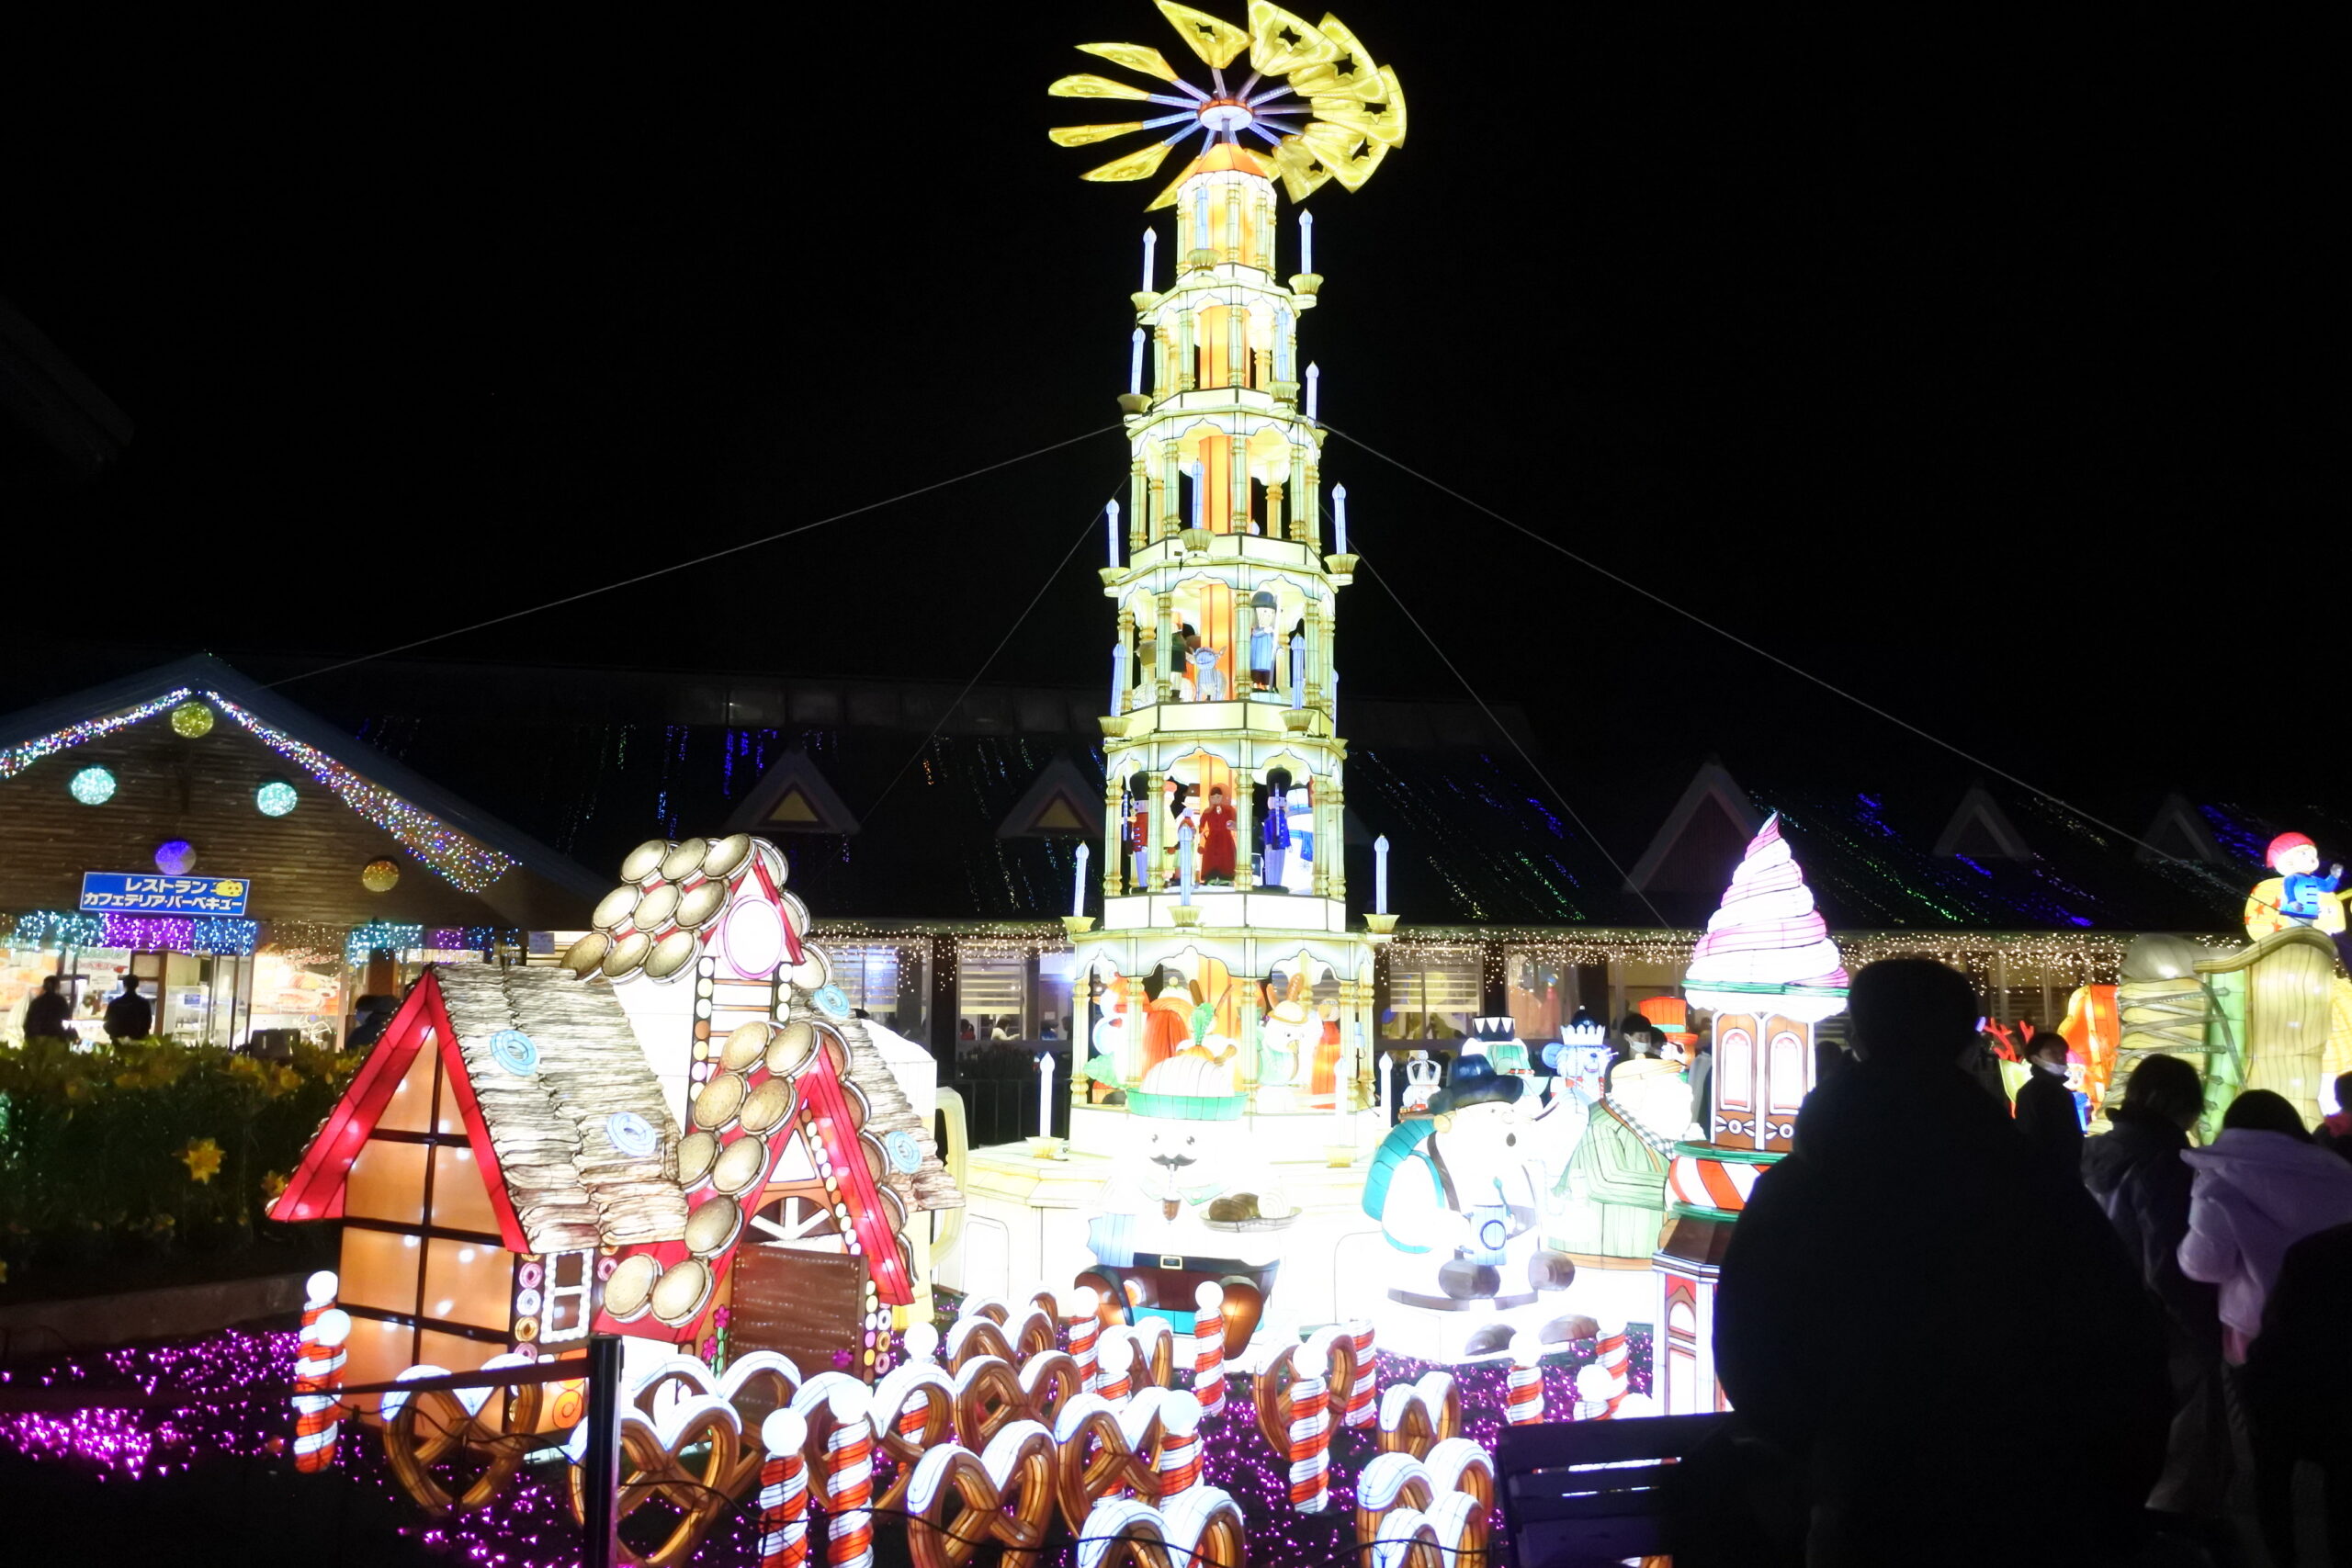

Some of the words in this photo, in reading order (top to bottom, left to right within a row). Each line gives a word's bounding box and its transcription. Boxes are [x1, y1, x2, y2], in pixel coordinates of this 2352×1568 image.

[125, 878, 208, 894] レストラン
